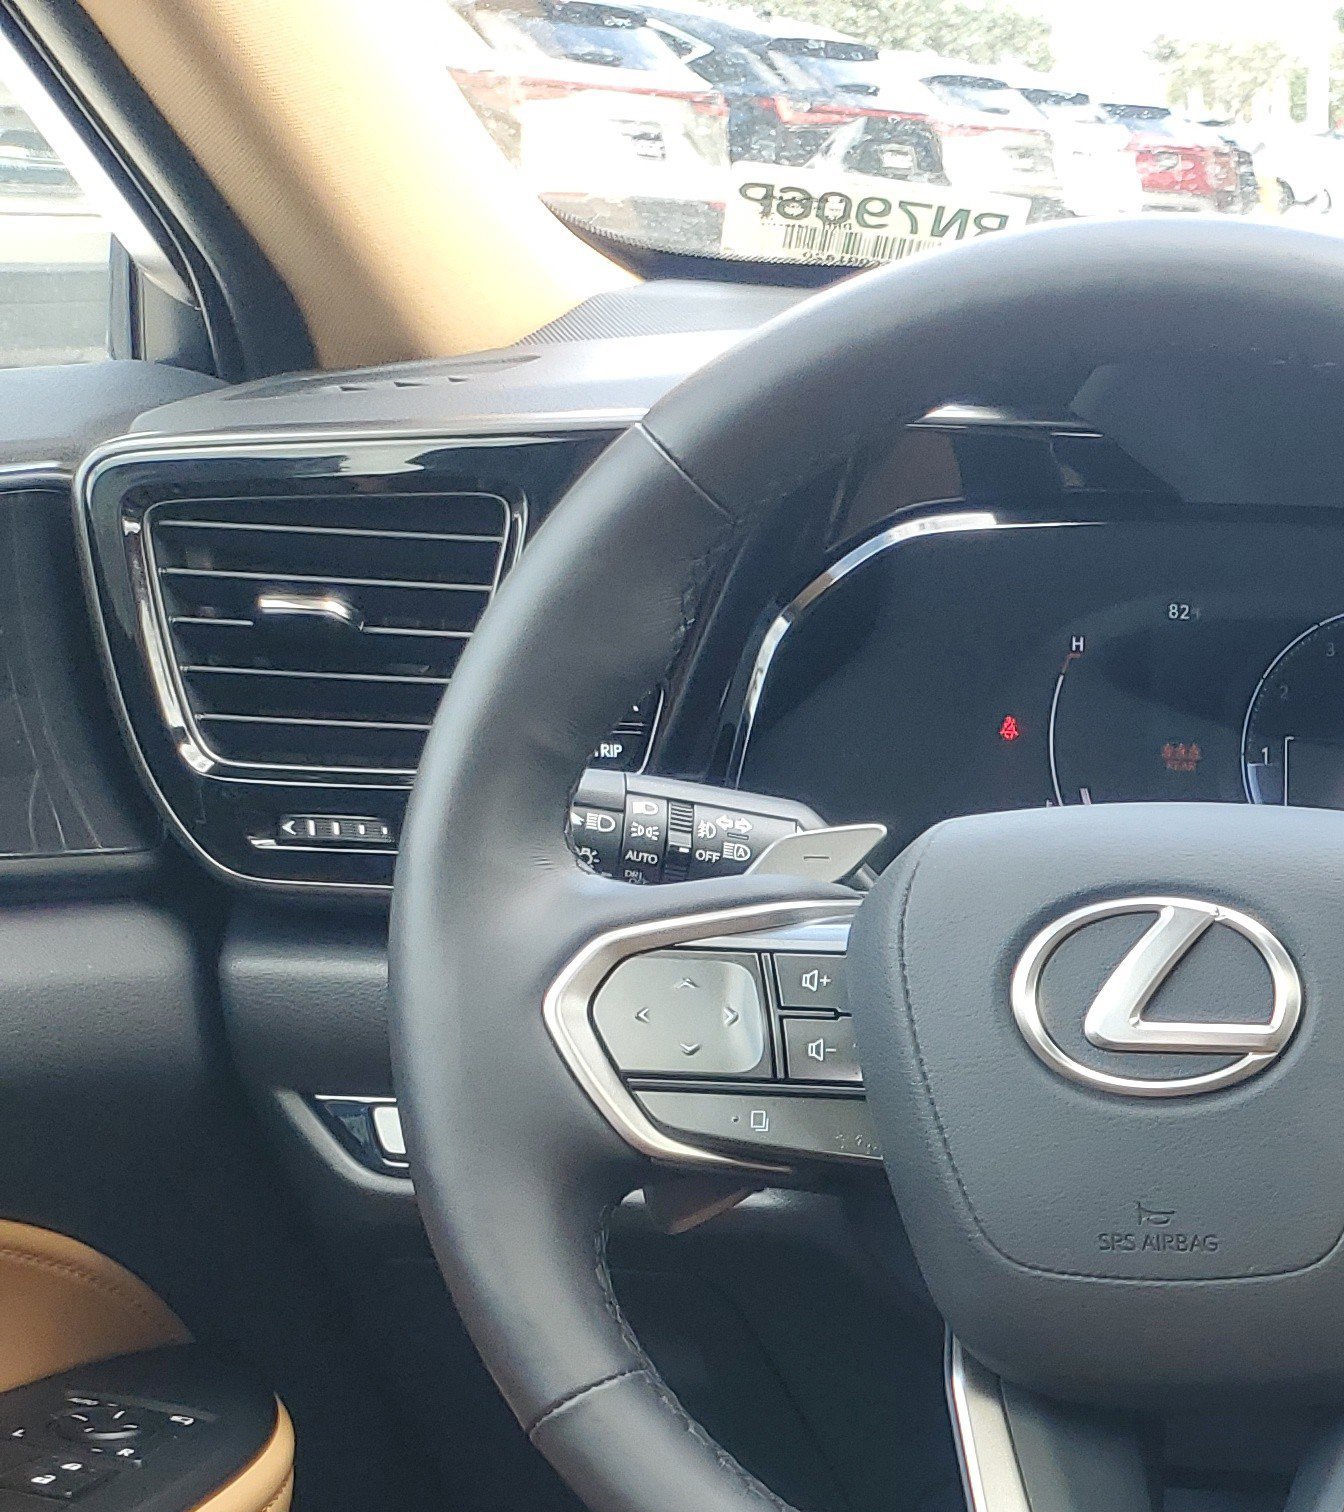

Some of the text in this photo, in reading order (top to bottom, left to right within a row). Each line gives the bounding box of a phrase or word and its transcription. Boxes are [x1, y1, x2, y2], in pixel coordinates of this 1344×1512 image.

[1071, 635, 1084, 652] H
[625, 850, 658, 864] AUTO
[695, 850, 720, 863] OFF
